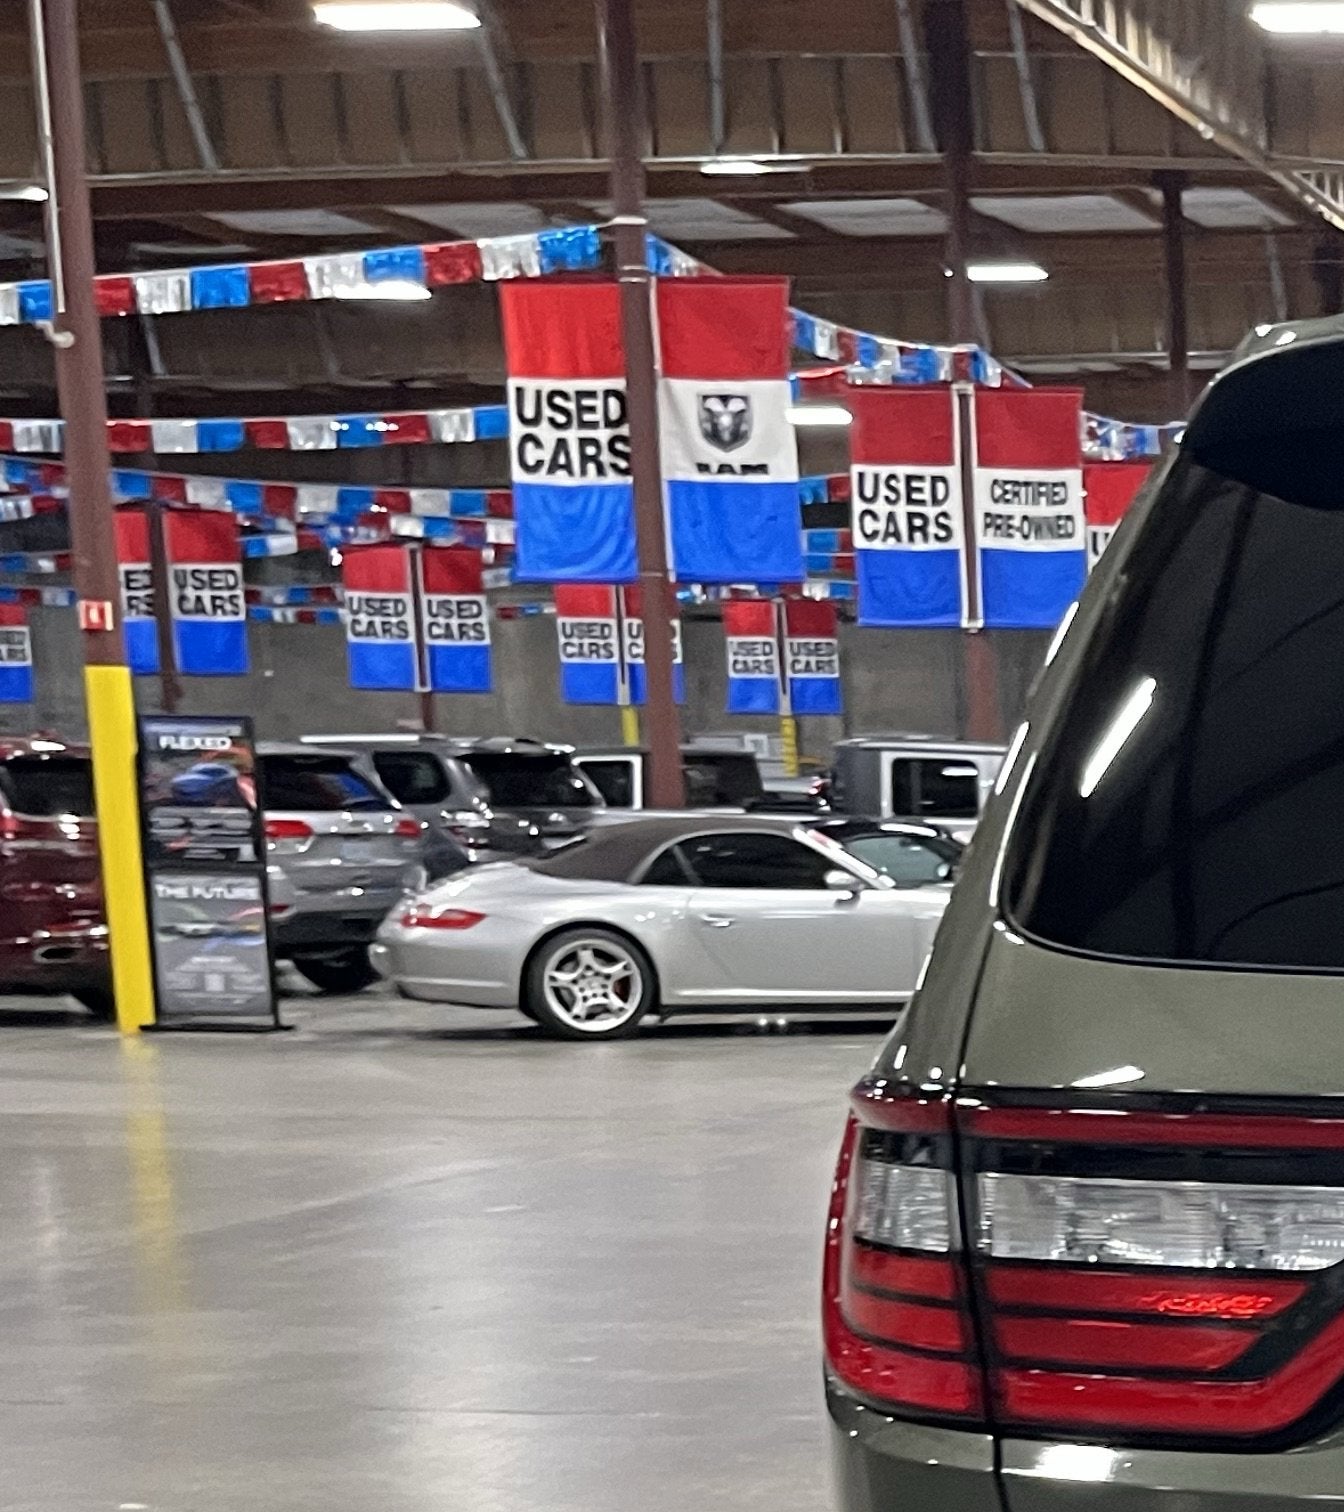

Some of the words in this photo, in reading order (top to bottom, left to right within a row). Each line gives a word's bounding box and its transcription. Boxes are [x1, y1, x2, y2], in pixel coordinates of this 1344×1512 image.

[515, 387, 627, 430] USED
[518, 433, 631, 477] CARS
[857, 472, 949, 506] USED
[991, 479, 1068, 506] CERTIFIED
[859, 509, 953, 543] CARS
[983, 512, 1075, 540] PRE-OWNED
[173, 569, 239, 590] USED
[178, 594, 240, 616] CARS
[349, 597, 406, 617] USED
[427, 599, 482, 619] USED
[351, 619, 409, 639] CARS
[428, 622, 485, 641] CARS
[562, 622, 612, 640] USED
[562, 642, 614, 659] CARS
[732, 659, 775, 675] CARS
[790, 659, 836, 675] CARS
